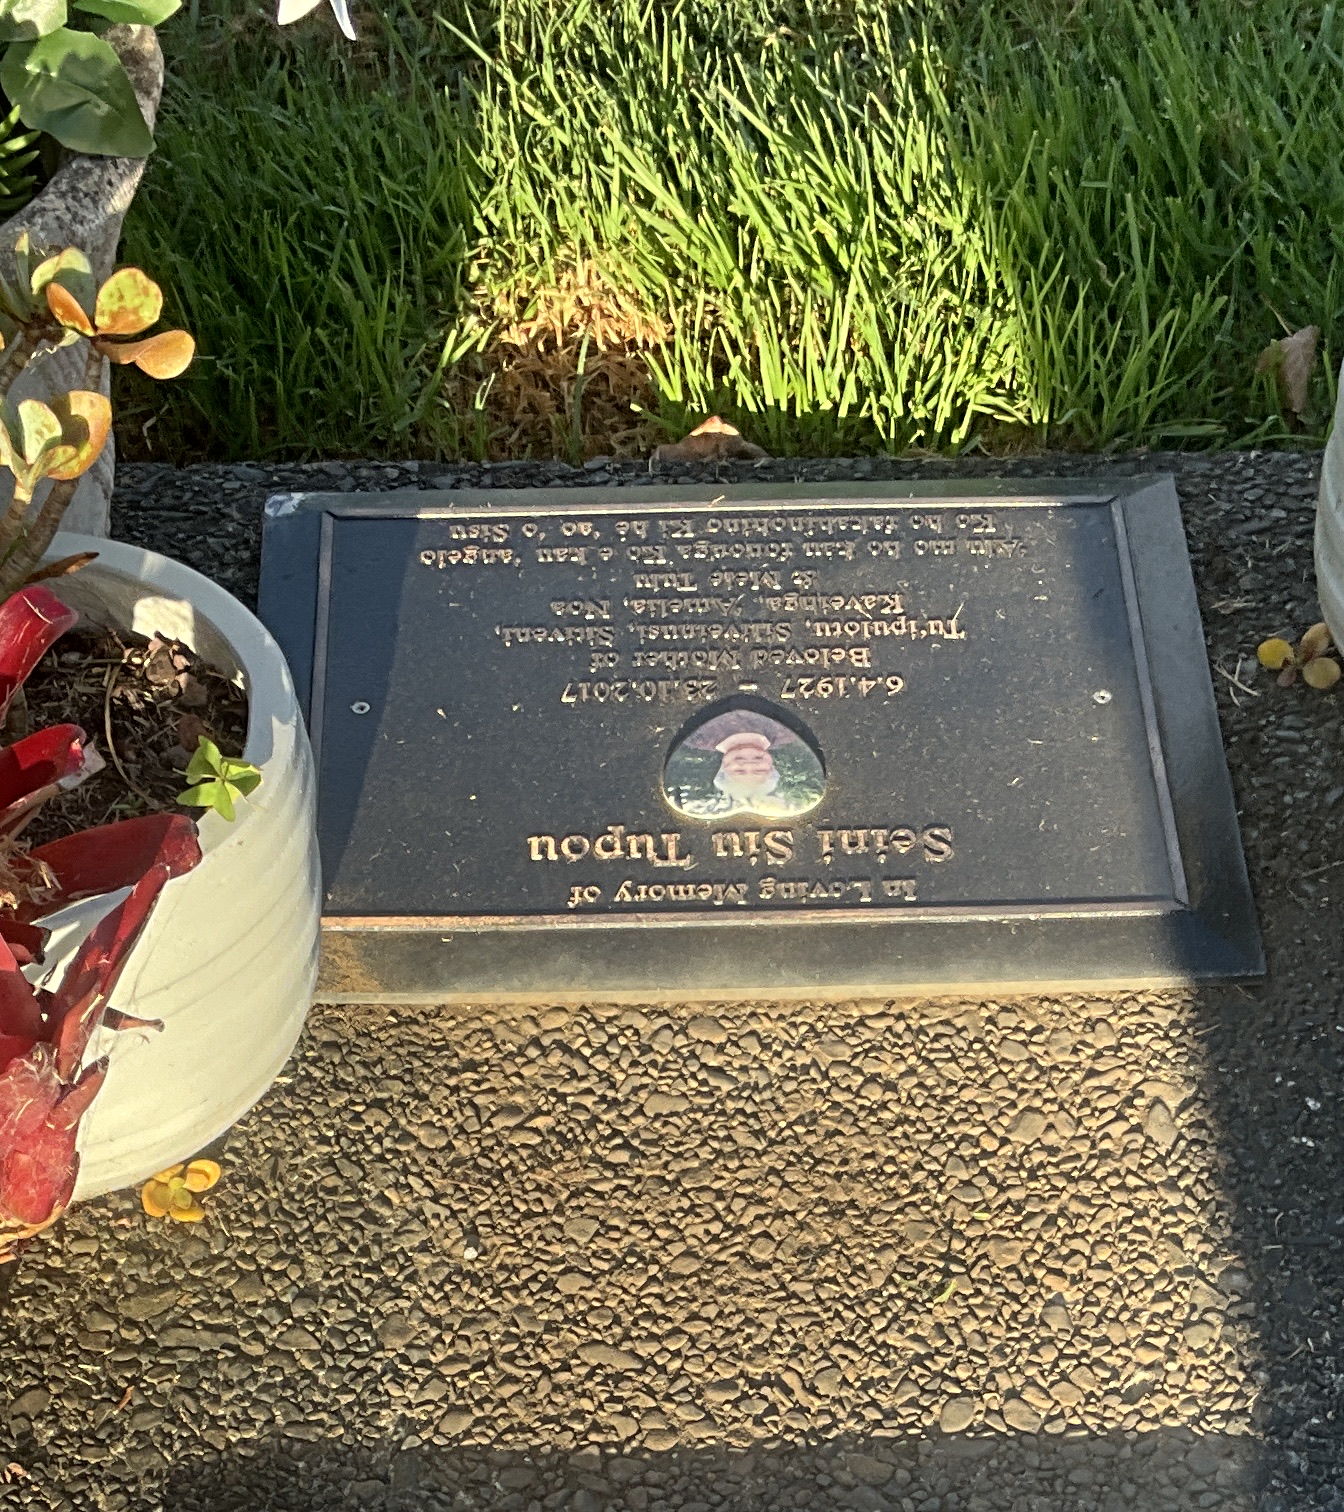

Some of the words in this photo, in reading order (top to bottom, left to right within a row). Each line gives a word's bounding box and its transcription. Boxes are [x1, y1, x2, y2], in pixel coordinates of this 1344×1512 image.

[450, 524, 509, 542] Sisu
[659, 520, 694, 538] Ki
[956, 514, 996, 533] Ko
[626, 546, 666, 564] Ko
[914, 540, 955, 555] mo
[792, 570, 816, 589] &
[550, 600, 610, 620] Noa
[588, 652, 620, 674] of
[632, 651, 740, 670] Mother
[750, 648, 870, 670] Beloved
[560, 680, 716, 703] 23.10.2017
[780, 676, 904, 698] 6.4.1927
[527, 826, 689, 867] Tupou
[712, 830, 794, 866] Siu
[816, 828, 954, 865] Seini
[568, 886, 601, 908] of
[614, 880, 747, 905] Memory
[758, 878, 872, 902] Loving
[884, 880, 916, 901] In
